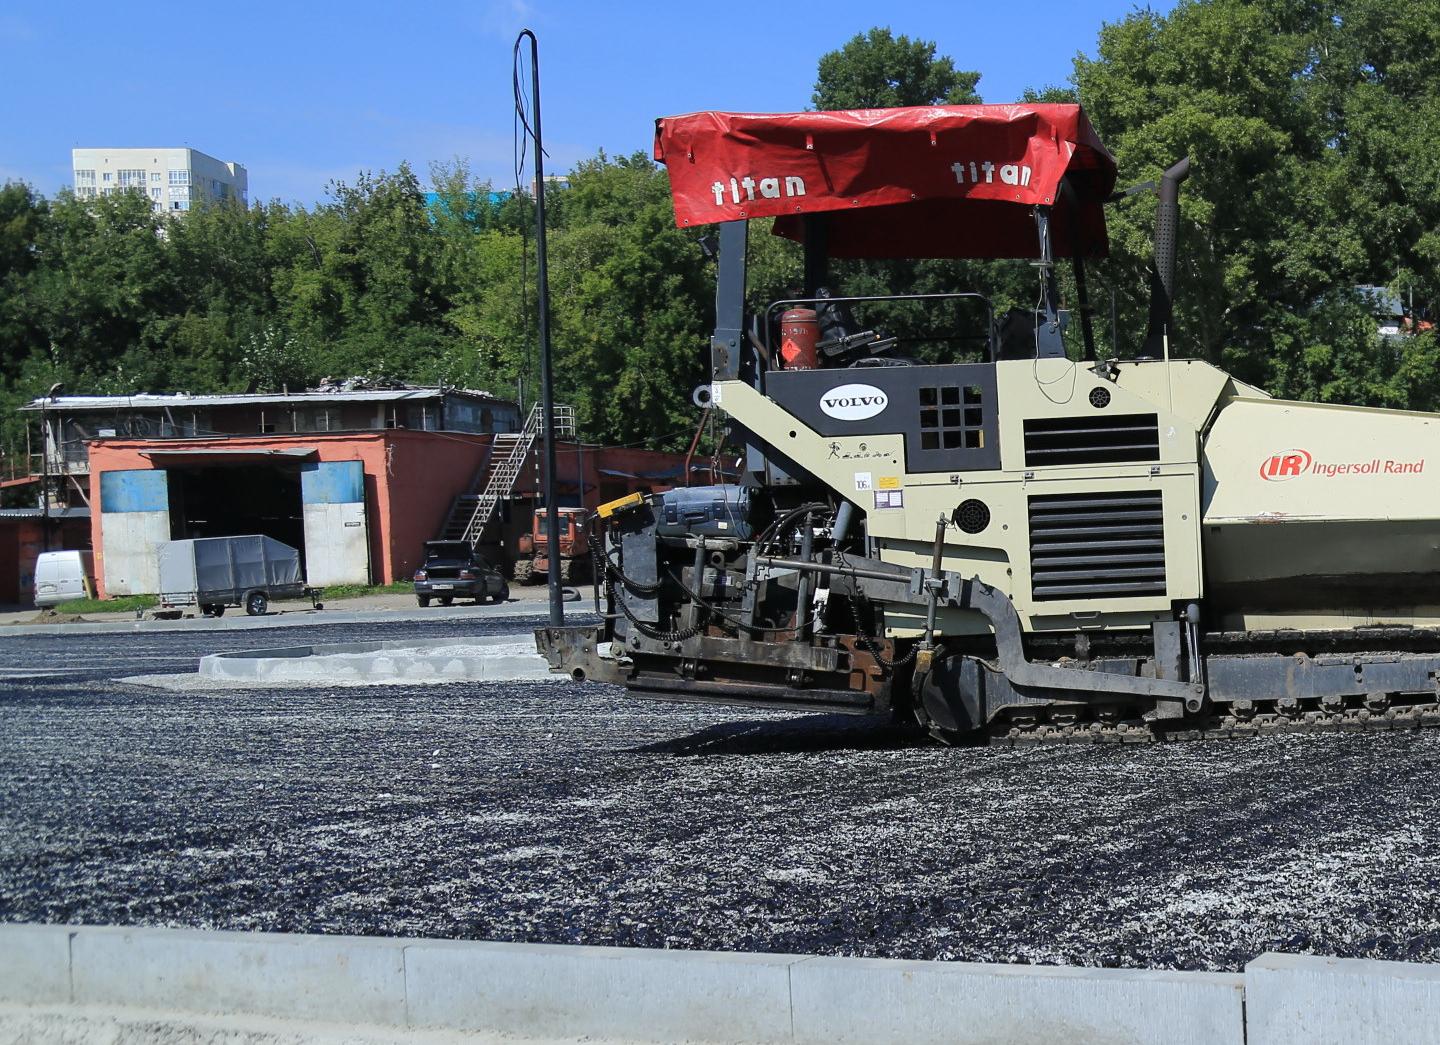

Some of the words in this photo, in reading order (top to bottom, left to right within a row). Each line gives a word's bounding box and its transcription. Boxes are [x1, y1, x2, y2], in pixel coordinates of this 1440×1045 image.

[951, 161, 1032, 187] titan
[711, 176, 806, 206] titan
[823, 395, 885, 408] VOLVO
[1312, 459, 1381, 478] Ingersoll
[1383, 459, 1425, 474] Rand
